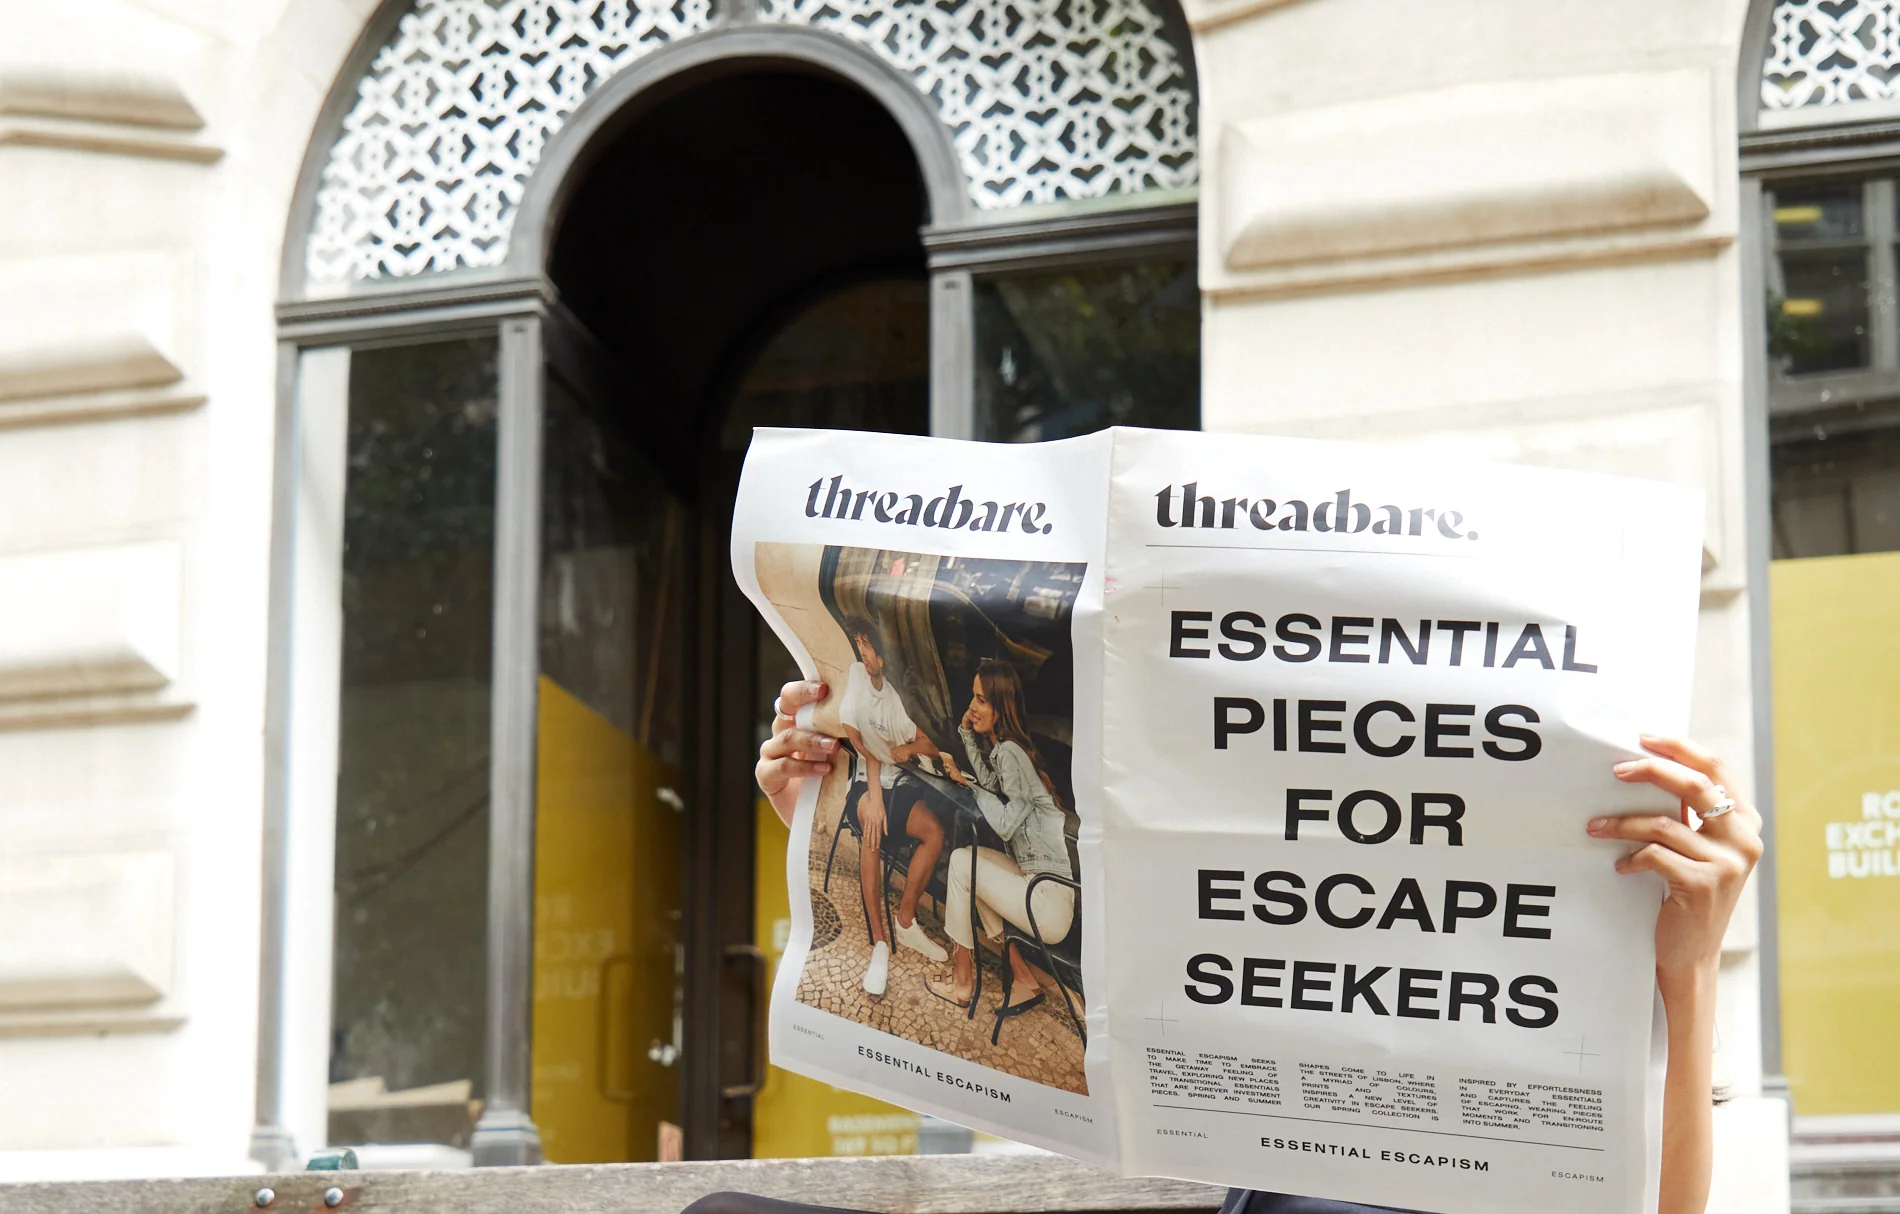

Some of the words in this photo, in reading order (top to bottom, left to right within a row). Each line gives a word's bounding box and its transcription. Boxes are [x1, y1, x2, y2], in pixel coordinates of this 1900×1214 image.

[806, 475, 1052, 534] threadbare.
[1155, 481, 1480, 541] threadbare.
[1170, 611, 1597, 673] ESSENTIAL
[1214, 697, 1542, 761] PIECES
[1285, 789, 1465, 846] FOR
[1828, 849, 1900, 878] BUIL
[1198, 869, 1556, 939] ESCAPE
[1185, 953, 1558, 1028] SEEKERS
[792, 1024, 826, 1041] ESSENTIAL
[1146, 1047, 1186, 1057] ESSENTIAL
[1198, 1052, 1238, 1062] ESCAPISM
[1251, 1057, 1276, 1065] SEEKS
[858, 1046, 932, 1078] ESSENTIAL
[936, 1071, 1012, 1103] ESCAPISM
[1175, 1063, 1209, 1072] GETAWAY
[1222, 1068, 1254, 1076] FEELING
[1240, 1063, 1277, 1072] EMBRACE
[1299, 1062, 1330, 1071] SHAPES
[1341, 1066, 1364, 1074] COME
[1169, 1076, 1222, 1087] TRANSITIONAL
[1234, 1082, 1280, 1092] ESSENTIALS
[1181, 1071, 1224, 1080] EXPLORING
[1249, 1077, 1279, 1085] PLACES
[1319, 1070, 1353, 1079] STREETS
[1407, 1079, 1435, 1088] WHERE
[1322, 1077, 1353, 1086] MYRIAD
[1194, 1085, 1229, 1094] FOREVER
[1233, 1089, 1281, 1099] INVESTMENT
[1301, 1081, 1330, 1090] PRINTS
[1396, 1091, 1437, 1101] TEXTURES
[1459, 1077, 1497, 1086] INSPIRED
[1527, 1084, 1602, 1097] EFFORTLESSNESS
[1488, 1087, 1530, 1097] EVERYDAY
[1552, 1094, 1602, 1104] ESSENTIALS
[1187, 1091, 1216, 1100] SPRING
[1247, 1097, 1282, 1106] SUMMER
[1302, 1088, 1338, 1098] INSPIRES
[1393, 1098, 1416, 1106] LEVEL
[1303, 1095, 1346, 1105] CREATIVITY
[1364, 1101, 1396, 1110] ESCAPE
[1487, 1094, 1531, 1104] CAPTURES
[1568, 1103, 1602, 1112] FEELING
[1054, 1108, 1094, 1125] ESCAPISM
[1331, 1105, 1361, 1113] SPRING
[1371, 1109, 1420, 1120] COLLECTION
[1461, 1105, 1480, 1113] THAT
[1494, 1108, 1519, 1116] WORK
[1528, 1105, 1566, 1115] WEARING
[1573, 1110, 1603, 1118] PIECES
[1462, 1112, 1503, 1121] MOMENTS
[1541, 1120, 1604, 1132] TRANSITIONING
[1462, 1118, 1482, 1126] INTO
[1156, 1128, 1210, 1140] ESSENTIAL
[1260, 1137, 1371, 1160] ESSENTIAL
[1380, 1150, 1490, 1173] ESCAPISM
[1551, 1170, 1605, 1184] ESCAPISM
